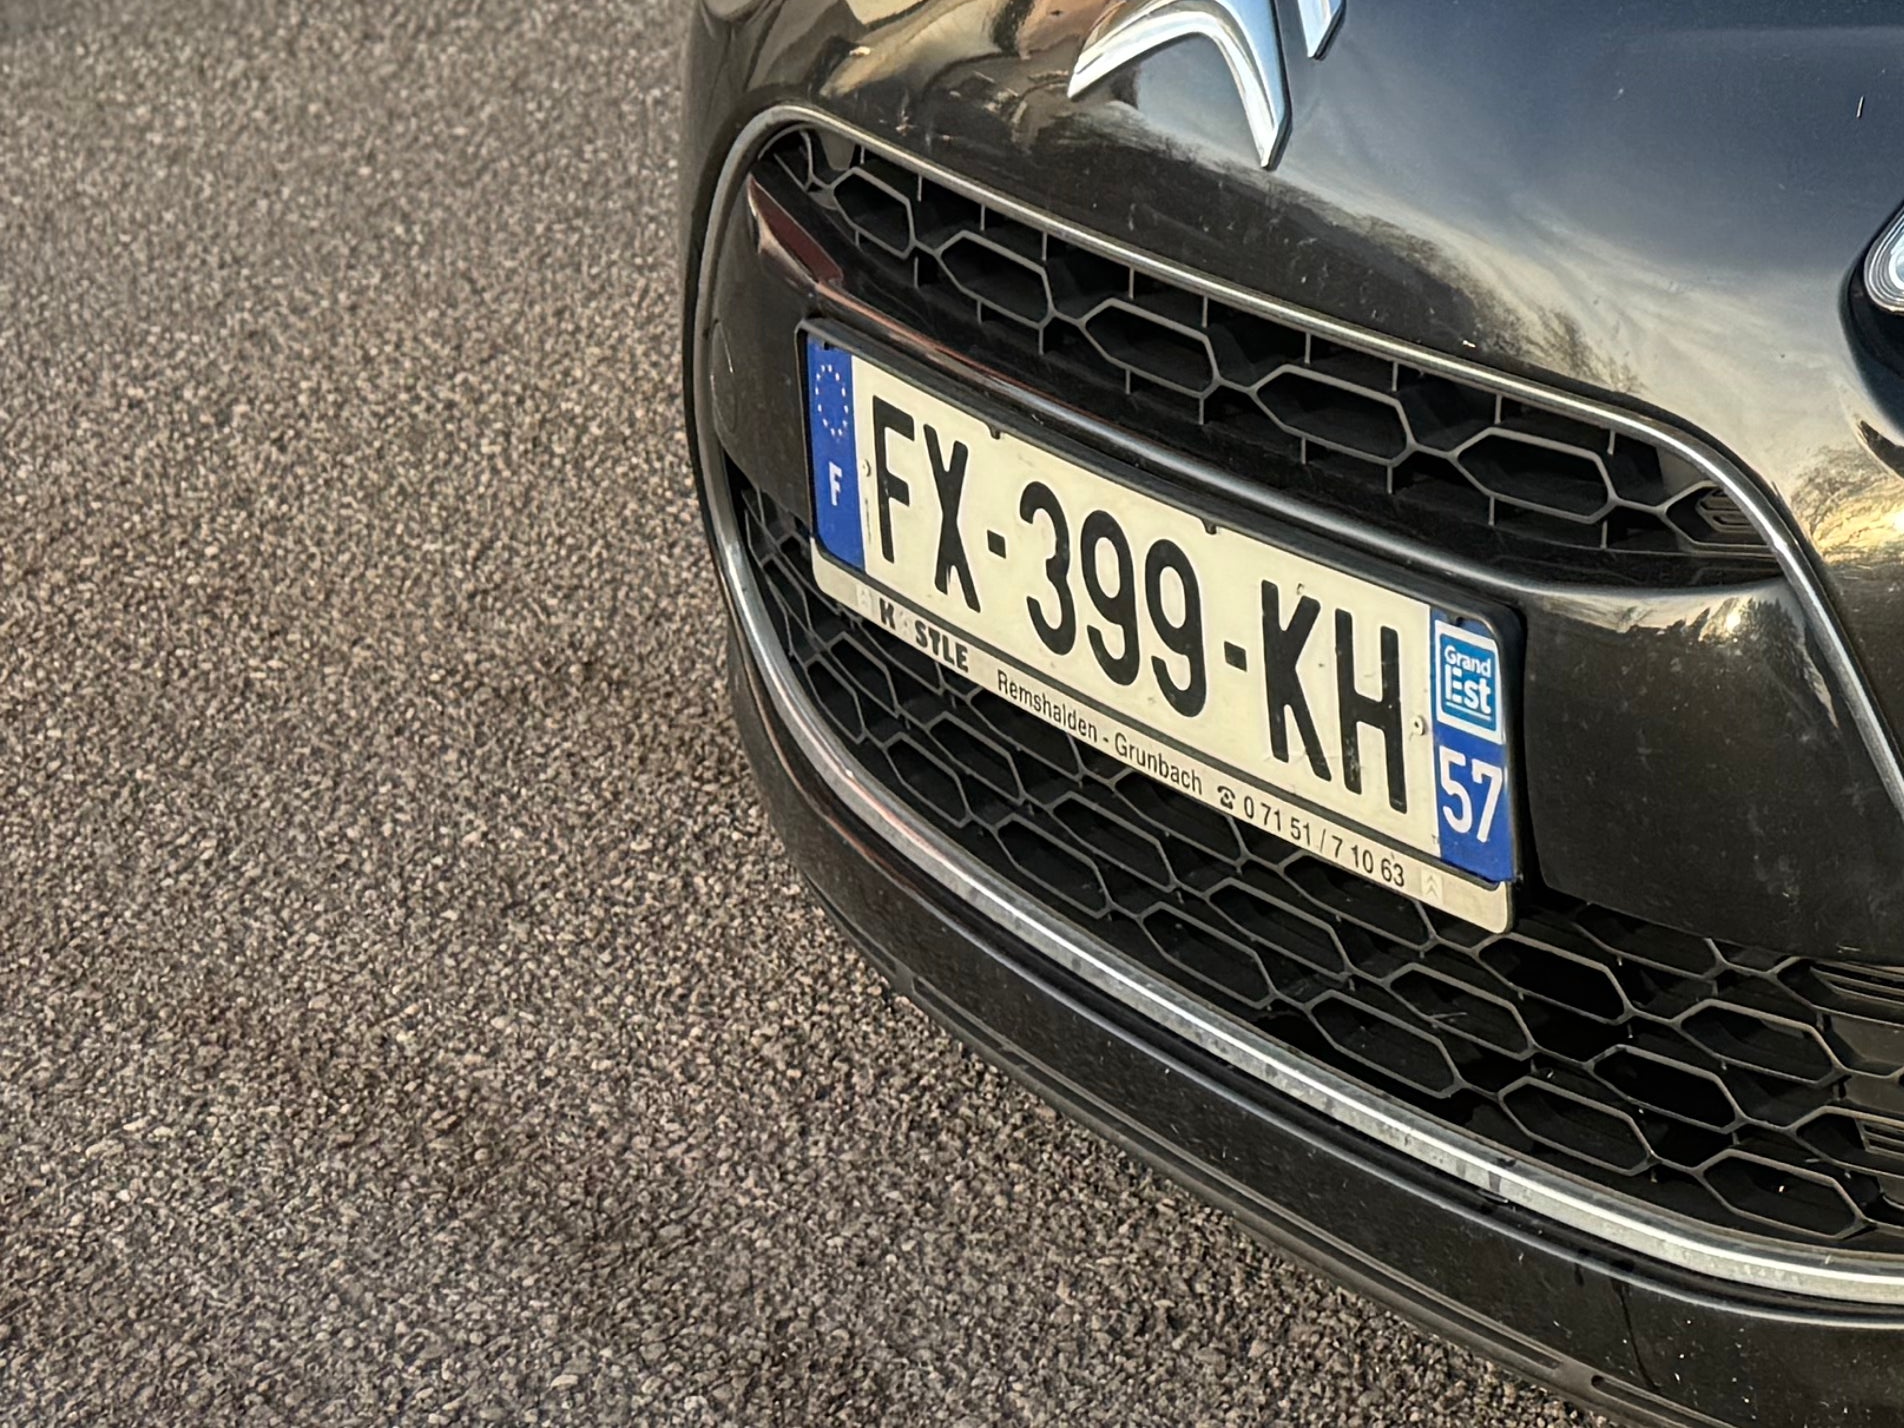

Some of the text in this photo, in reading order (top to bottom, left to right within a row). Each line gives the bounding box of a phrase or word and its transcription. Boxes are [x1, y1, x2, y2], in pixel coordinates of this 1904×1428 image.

[826, 460, 844, 508] F
[871, 394, 1409, 816] FX-399-KH
[1443, 644, 1492, 678] Grand
[1444, 663, 1492, 715] Est
[997, 668, 1098, 744] Remshalden
[1114, 731, 1203, 796] Grunbach
[1243, 795, 1255, 819] 0
[1259, 802, 1282, 831] 71
[1289, 819, 1311, 846] 51
[1330, 834, 1344, 858] 7
[1351, 844, 1374, 872] 10
[1380, 856, 1406, 888] 63
[1439, 744, 1503, 843] 57
